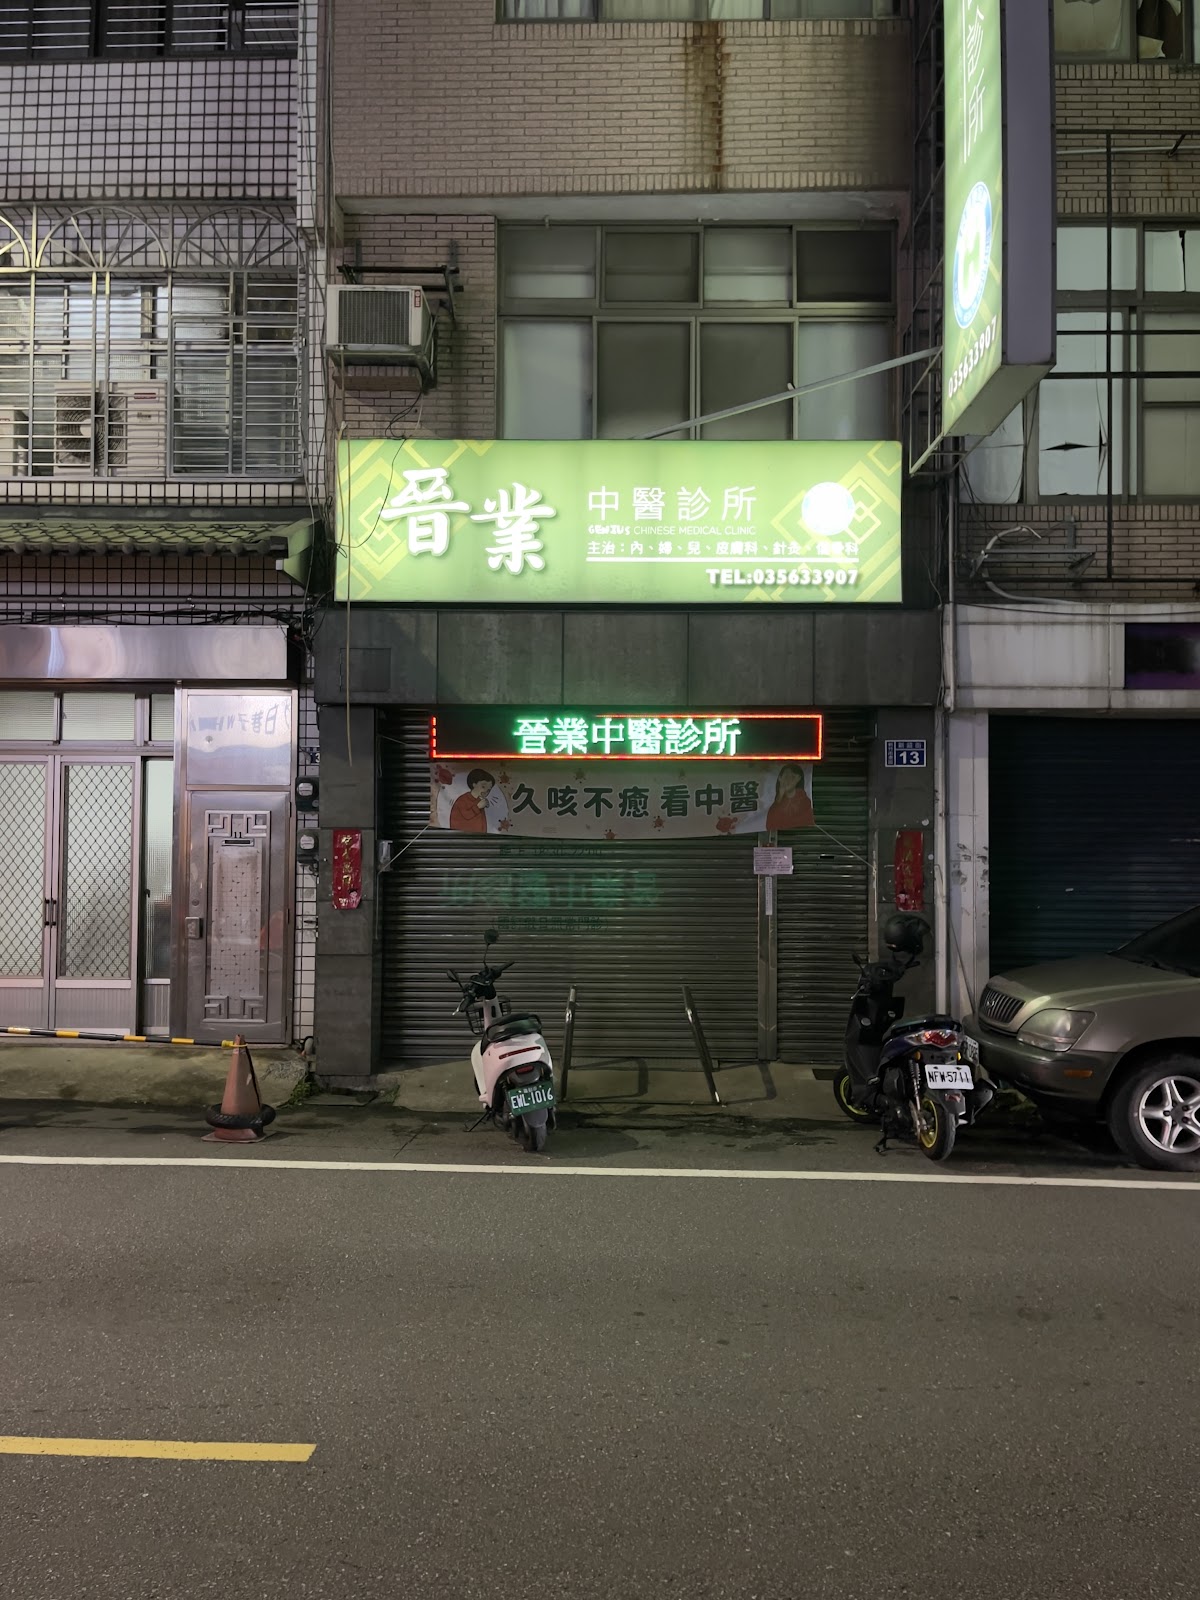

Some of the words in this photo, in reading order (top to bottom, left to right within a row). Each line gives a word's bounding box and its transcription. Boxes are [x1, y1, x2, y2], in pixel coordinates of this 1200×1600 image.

[967, 0, 986, 157] 診所
[948, 315, 997, 398] 035633907
[382, 467, 557, 575] 晉業
[588, 486, 757, 522] 中醫診所
[634, 525, 676, 536] CHINESE
[678, 525, 722, 536] MEDICAL
[724, 525, 757, 536] CLINIC
[513, 717, 742, 756] 晉業中醫診所
[899, 751, 920, 765] 13
